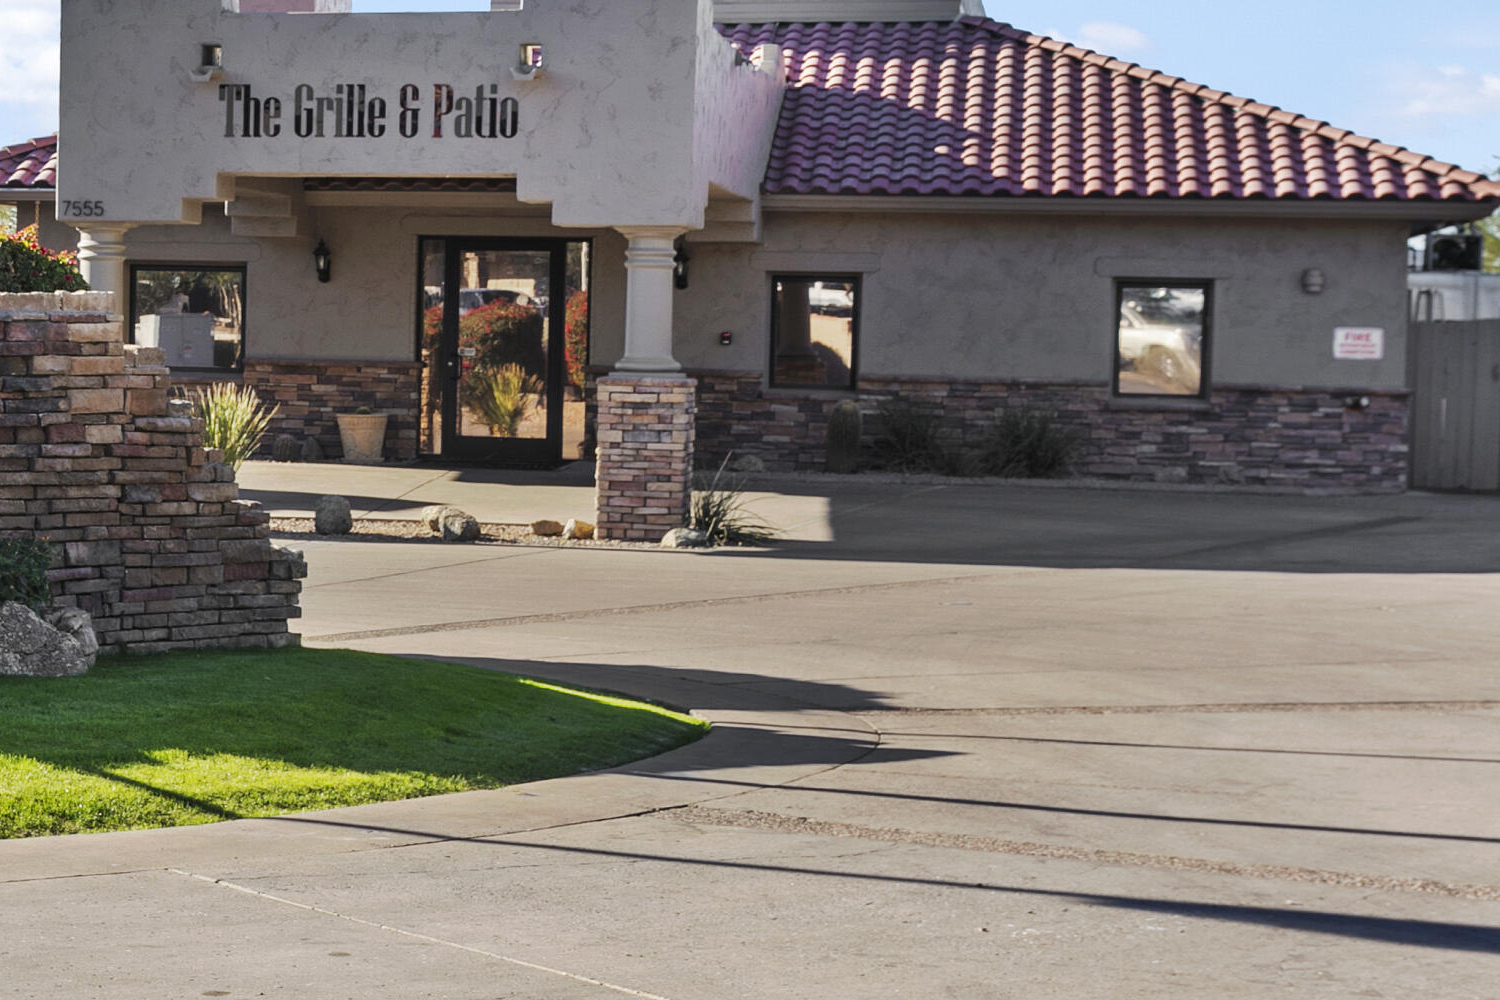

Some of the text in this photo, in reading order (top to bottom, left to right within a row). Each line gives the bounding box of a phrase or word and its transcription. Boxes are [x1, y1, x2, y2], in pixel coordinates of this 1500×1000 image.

[219, 83, 518, 138] The Grille & Patio
[62, 200, 104, 217] 7555
